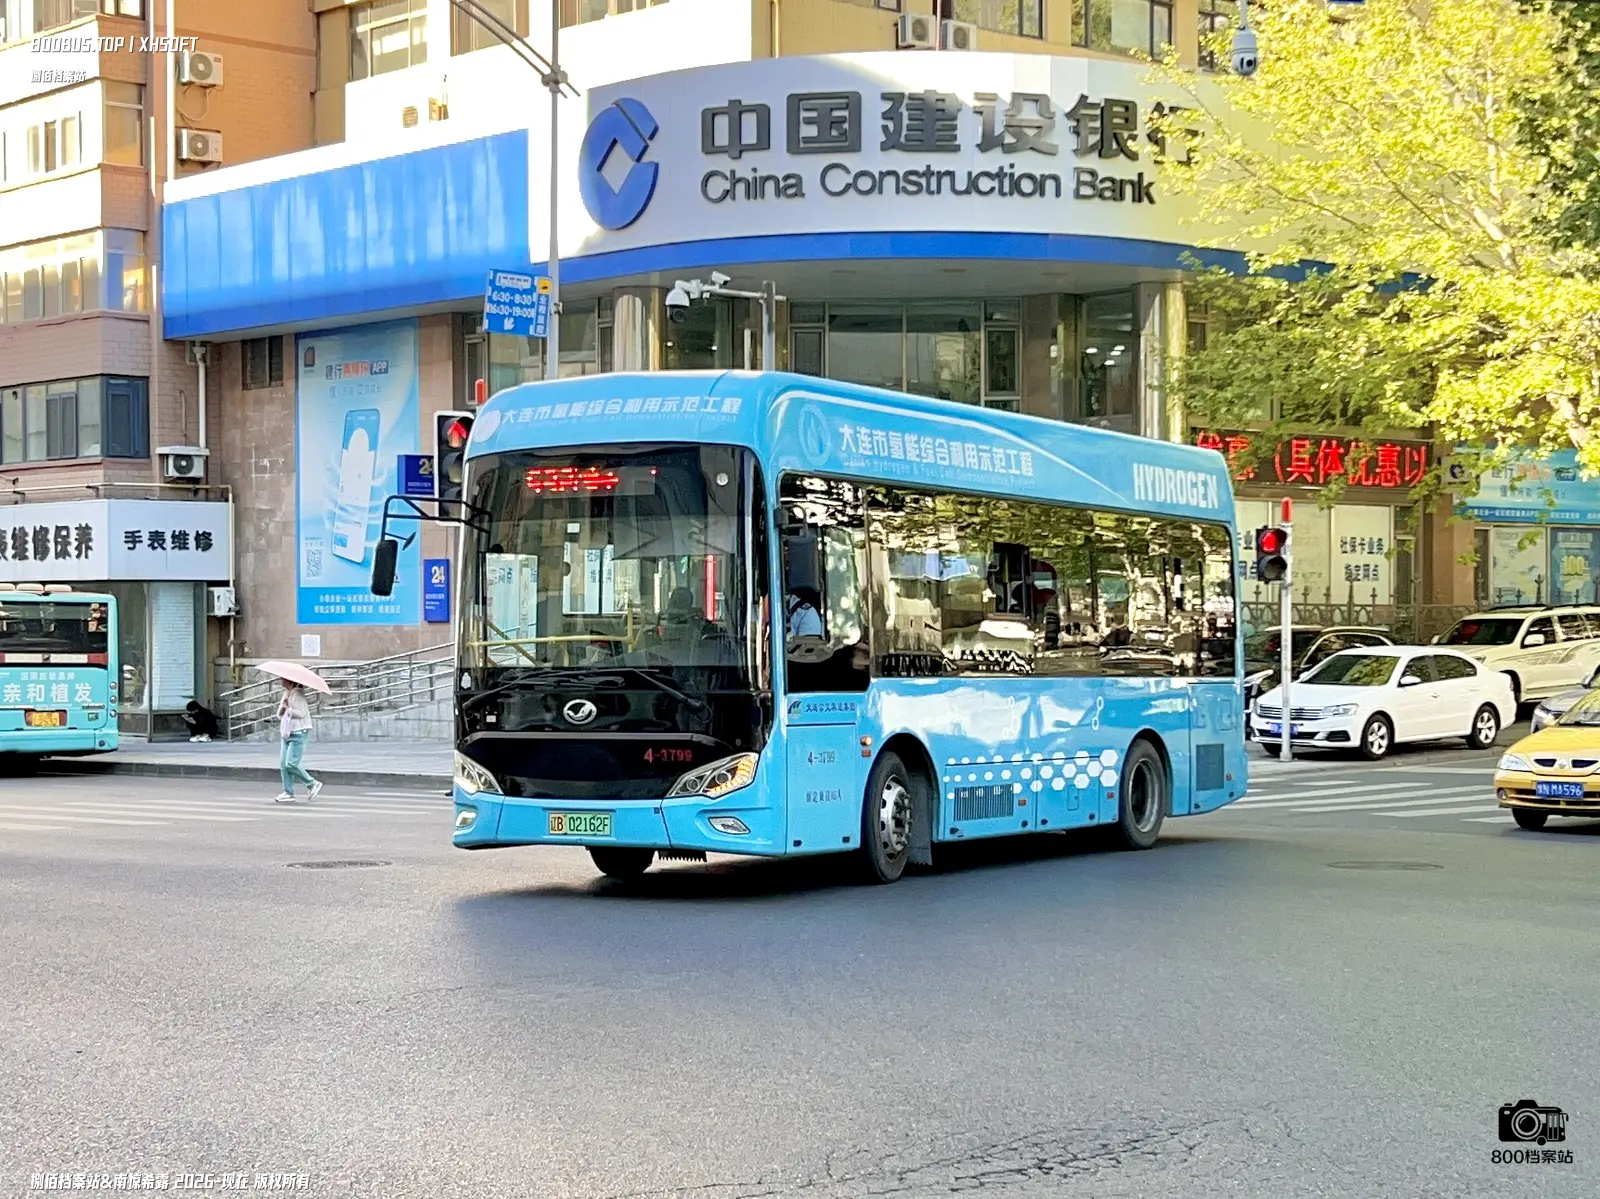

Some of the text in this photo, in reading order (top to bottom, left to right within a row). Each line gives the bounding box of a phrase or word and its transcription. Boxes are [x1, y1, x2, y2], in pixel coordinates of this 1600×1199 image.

[701, 88, 1204, 167] 中国建设银行
[700, 161, 1157, 205] China Construction Bank
[502, 396, 742, 425] 大连市氢能综合利用示范工程
[839, 423, 1034, 477] 大连市氢能综合利用示范工程
[1133, 463, 1219, 509] HYDROGEN
[124, 529, 214, 552] 手表维修
[3, 682, 93, 703] 亲和植发
